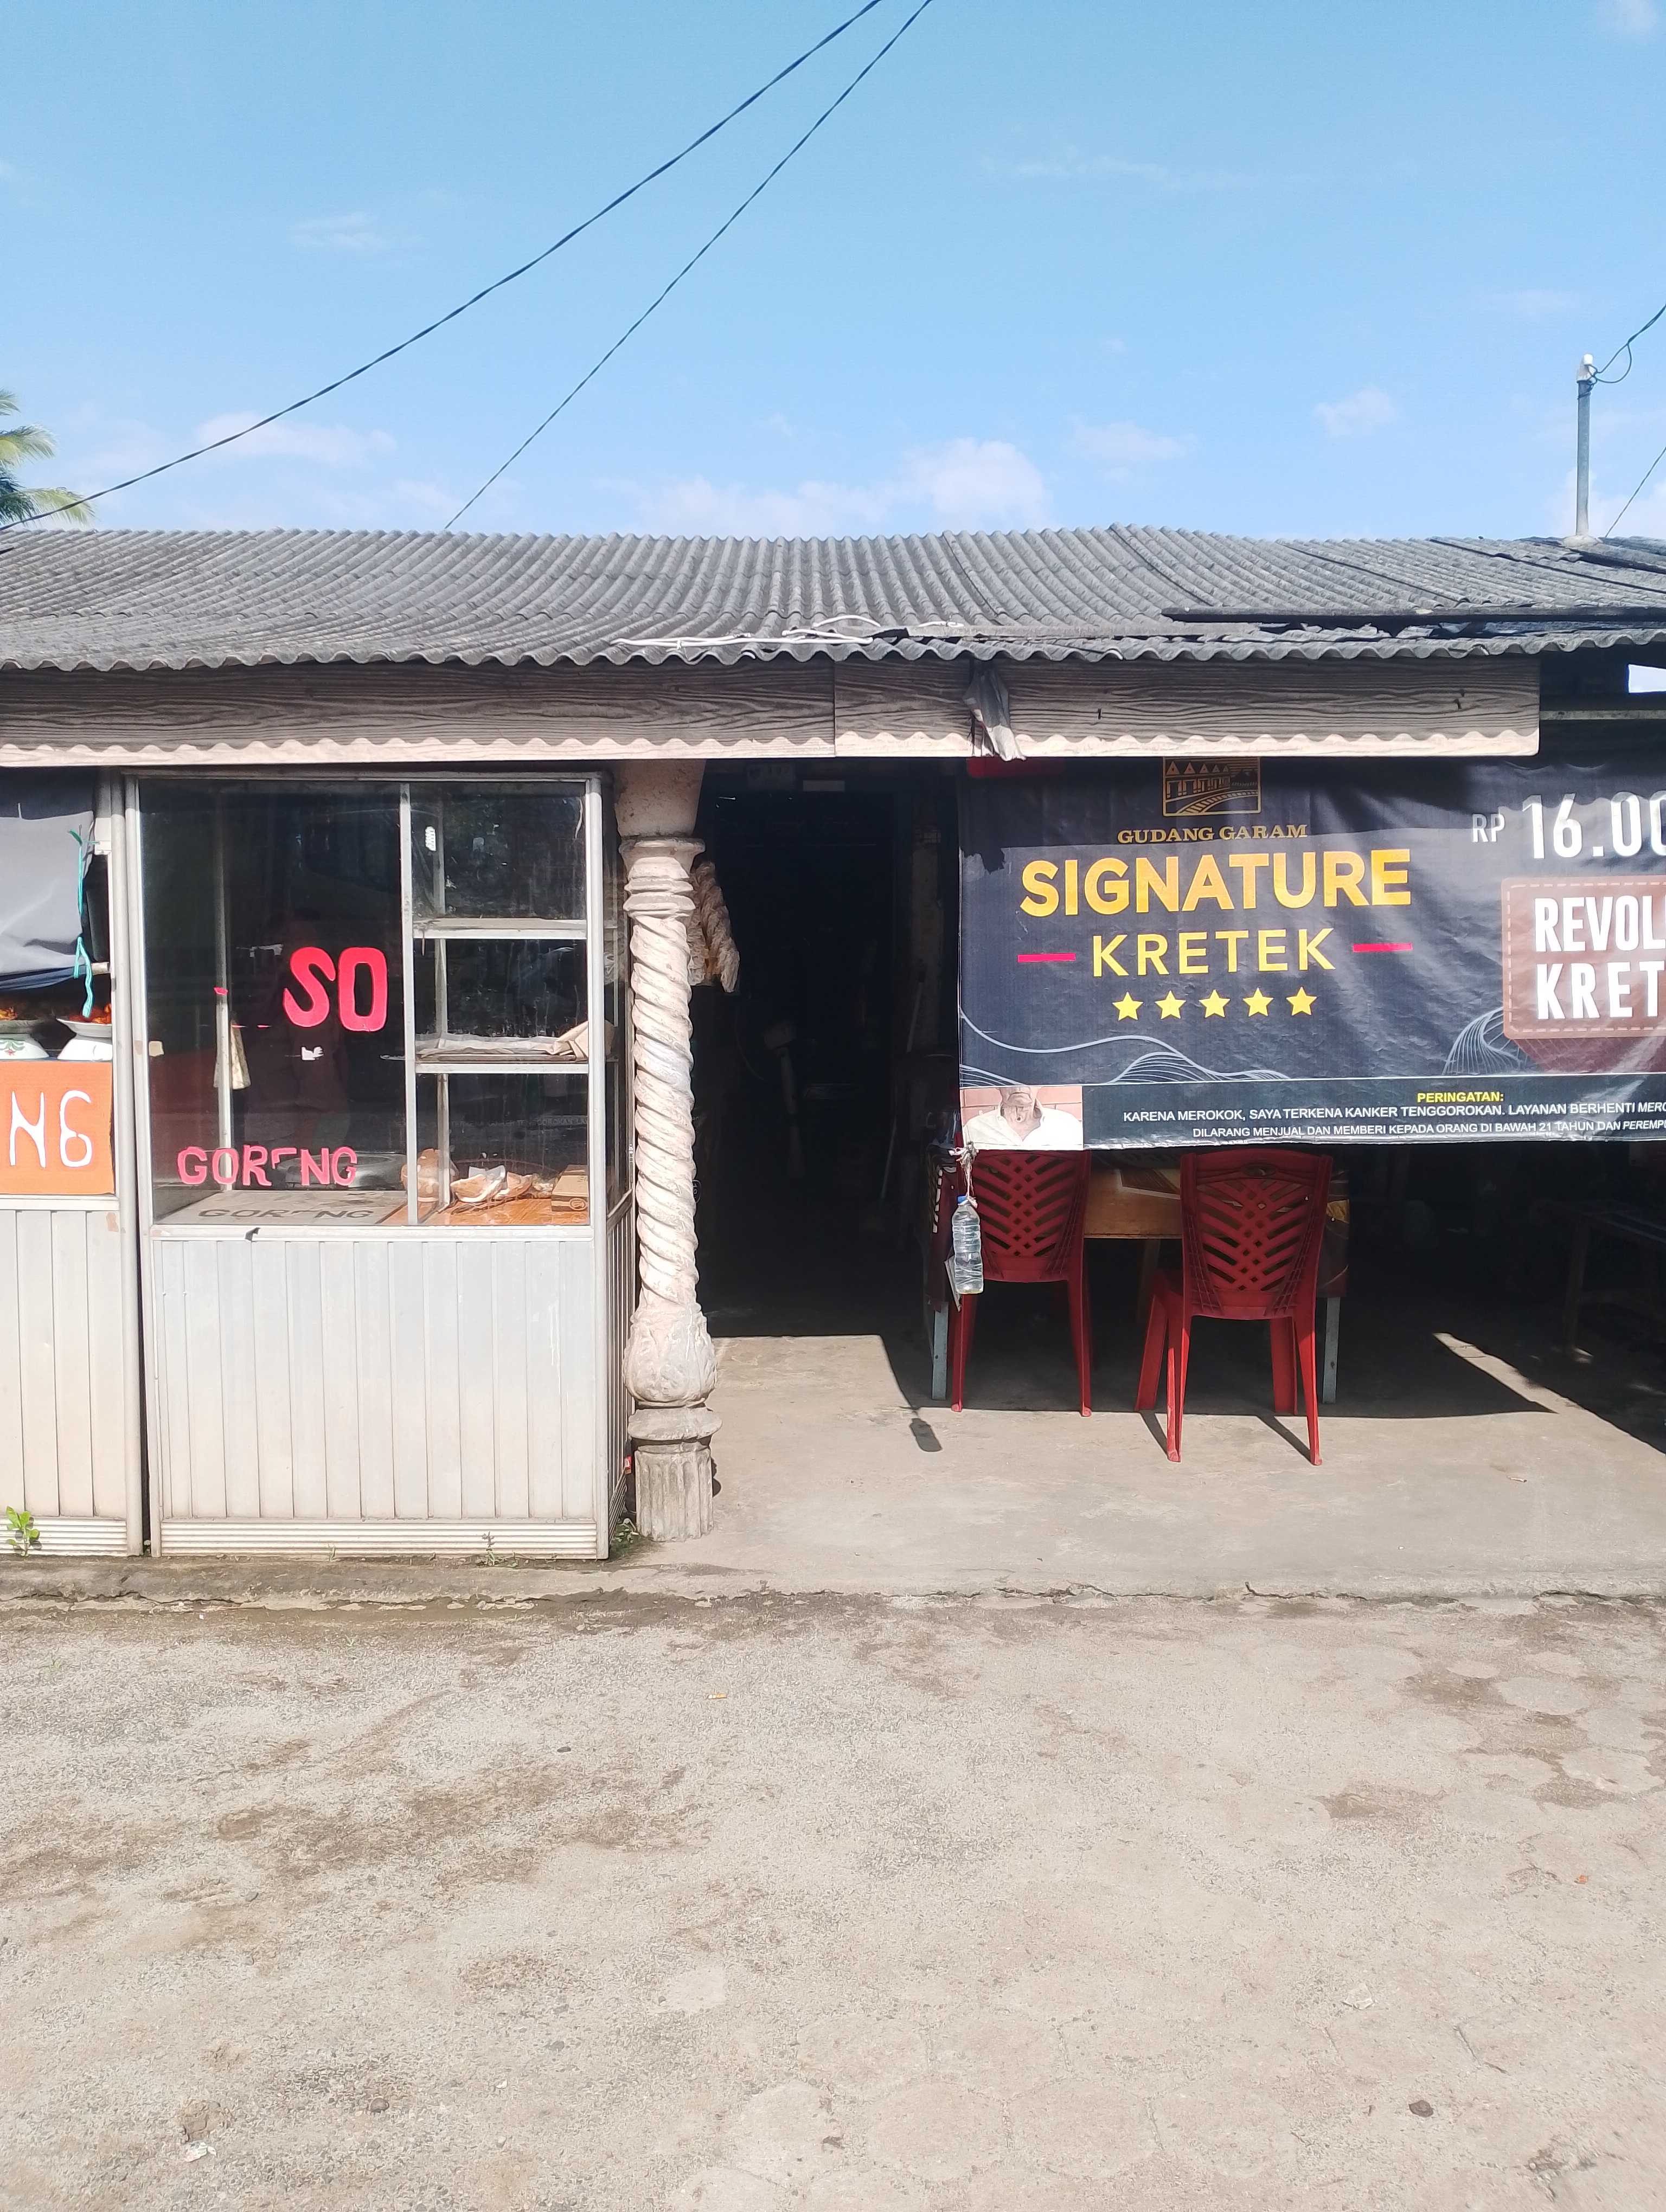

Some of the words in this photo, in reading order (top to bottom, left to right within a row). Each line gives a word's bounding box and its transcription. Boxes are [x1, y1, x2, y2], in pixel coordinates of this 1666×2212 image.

[1117, 826, 1214, 844] GUDANG
[1219, 824, 1308, 840] GARAM
[1472, 807, 1505, 842] RP
[1020, 848, 1412, 917] SIGNATURE
[1534, 895, 1666, 952] REVOL
[1093, 928, 1336, 977] KRETEK
[283, 946, 388, 1032] SO
[1536, 960, 1665, 1020] KRET
[1123, 1111, 1176, 1122] KARENA
[1178, 1109, 1246, 1121] MEROKOK,
[1249, 1109, 1282, 1120] SAYA
[1283, 1108, 1343, 1119] TERKENA
[1345, 1107, 1398, 1118] KANKER
[1400, 1105, 1505, 1117] TENGGOROKAN.
[1509, 1104, 1567, 1115] LAYANAN
[1570, 1103, 1635, 1114] BERHENTI
[1417, 1091, 1504, 1103] PERINGATAN:
[1193, 1127, 1251, 1137] DILARANG
[1253, 1127, 1305, 1136] MENJUAL
[1307, 1126, 1330, 1135] DAN
[1334, 1125, 1387, 1135] MEMBERI
[1389, 1124, 1434, 1134] KEPADA
[1437, 1123, 1478, 1133] ORANG
[1481, 1123, 1492, 1133] DI
[1495, 1122, 1537, 1132] BAWAH
[1539, 1122, 1552, 1132] 21
[1554, 1121, 1594, 1131] TAHUN
[1597, 1121, 1620, 1131] DAN
[1623, 1120, 1666, 1130] PEREMP
